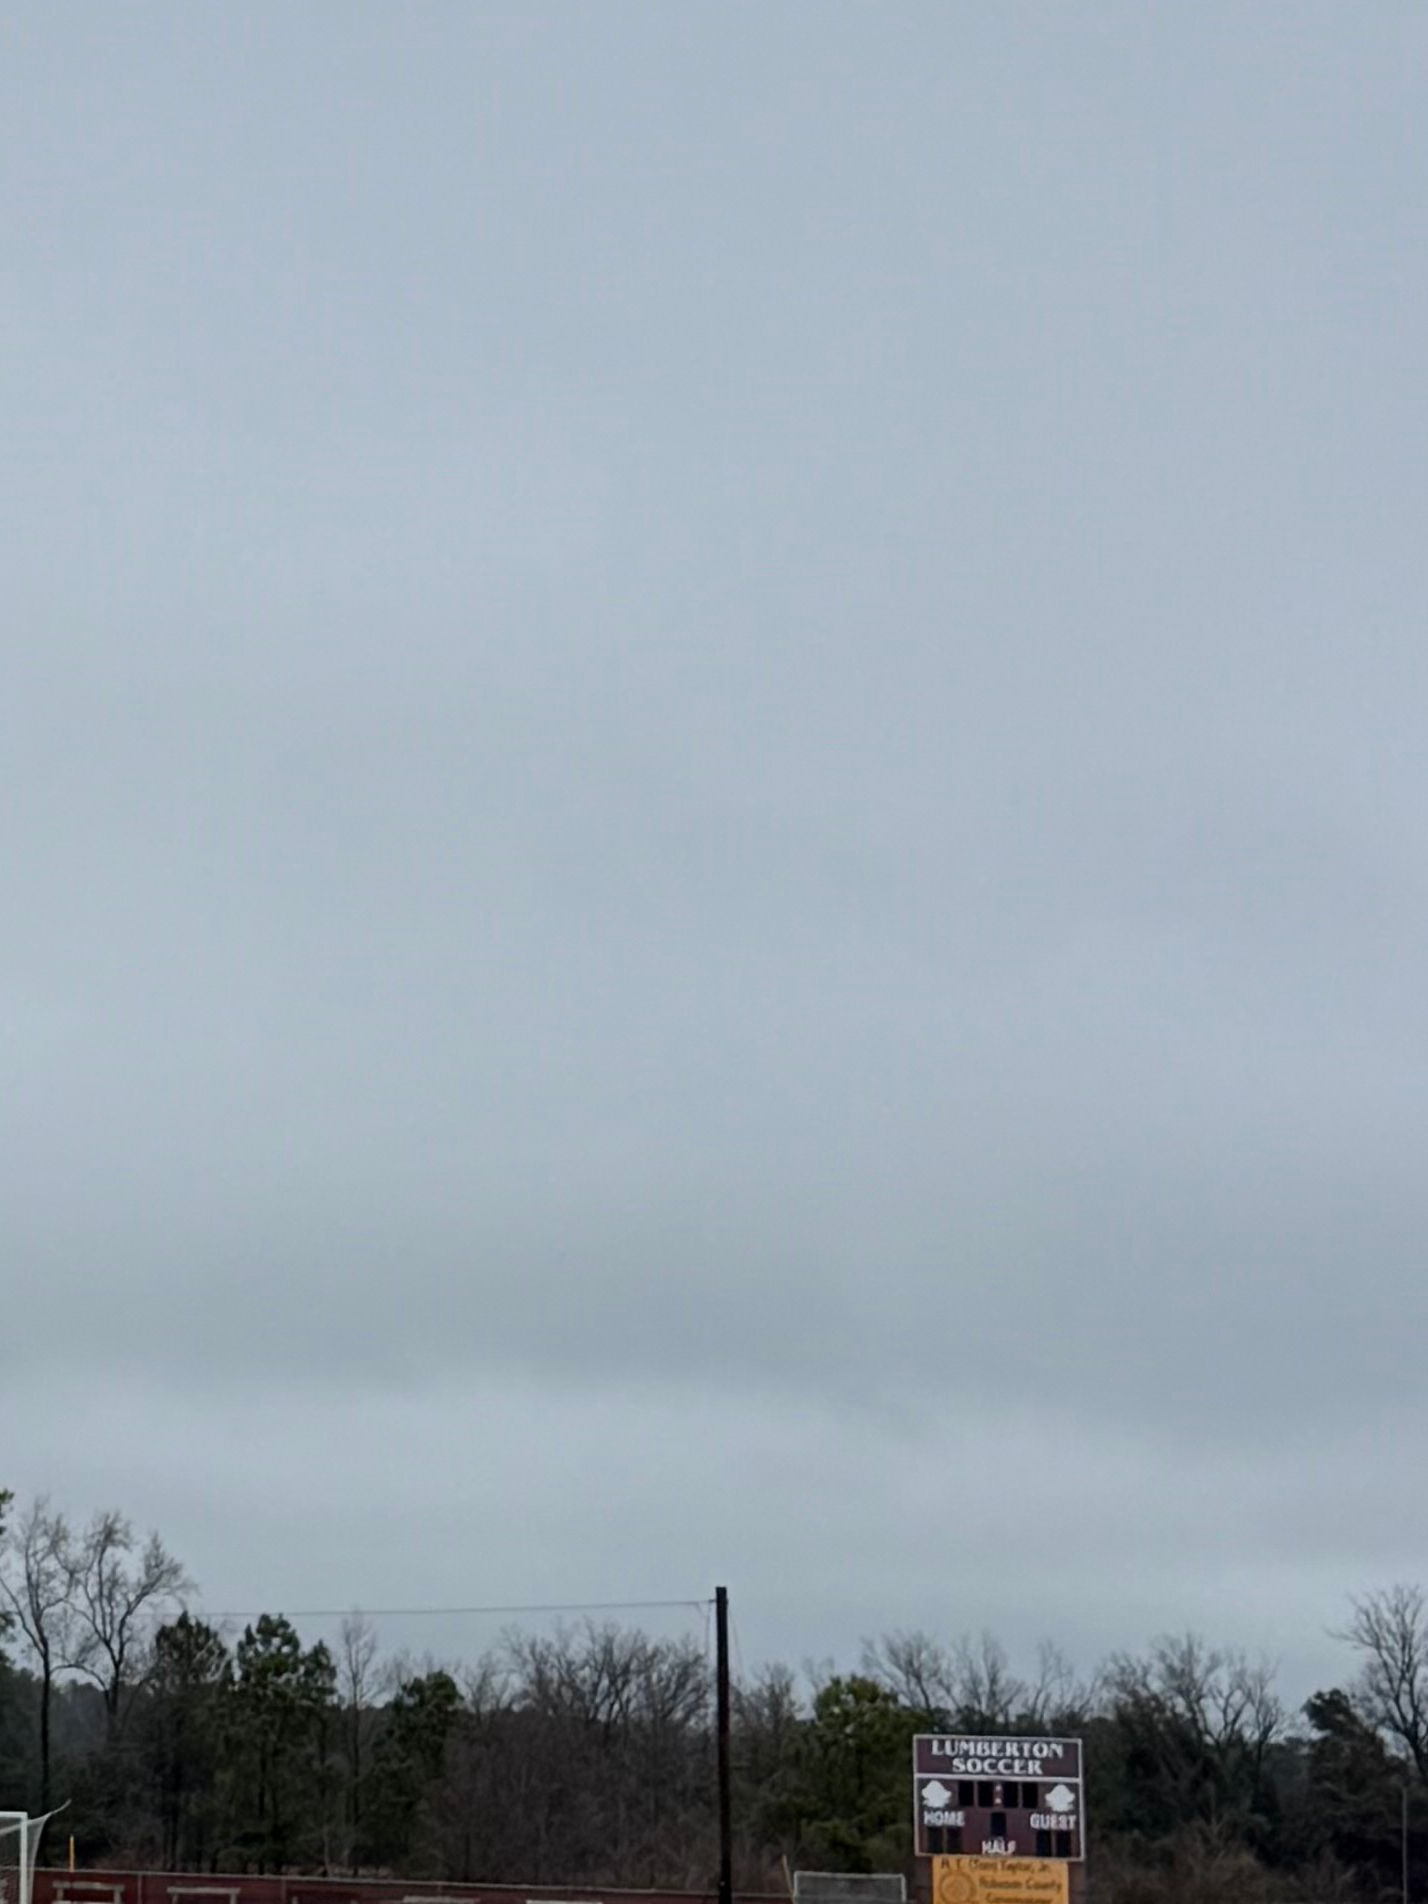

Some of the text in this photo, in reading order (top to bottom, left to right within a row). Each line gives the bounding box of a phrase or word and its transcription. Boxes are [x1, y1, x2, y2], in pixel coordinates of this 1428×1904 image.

[931, 1739, 1064, 1758] LUMBERTON
[952, 1757, 1043, 1775] SOCCER
[923, 1810, 966, 1827] HOME
[1029, 1813, 1077, 1830] GUEST
[981, 1839, 1016, 1855] HALF
